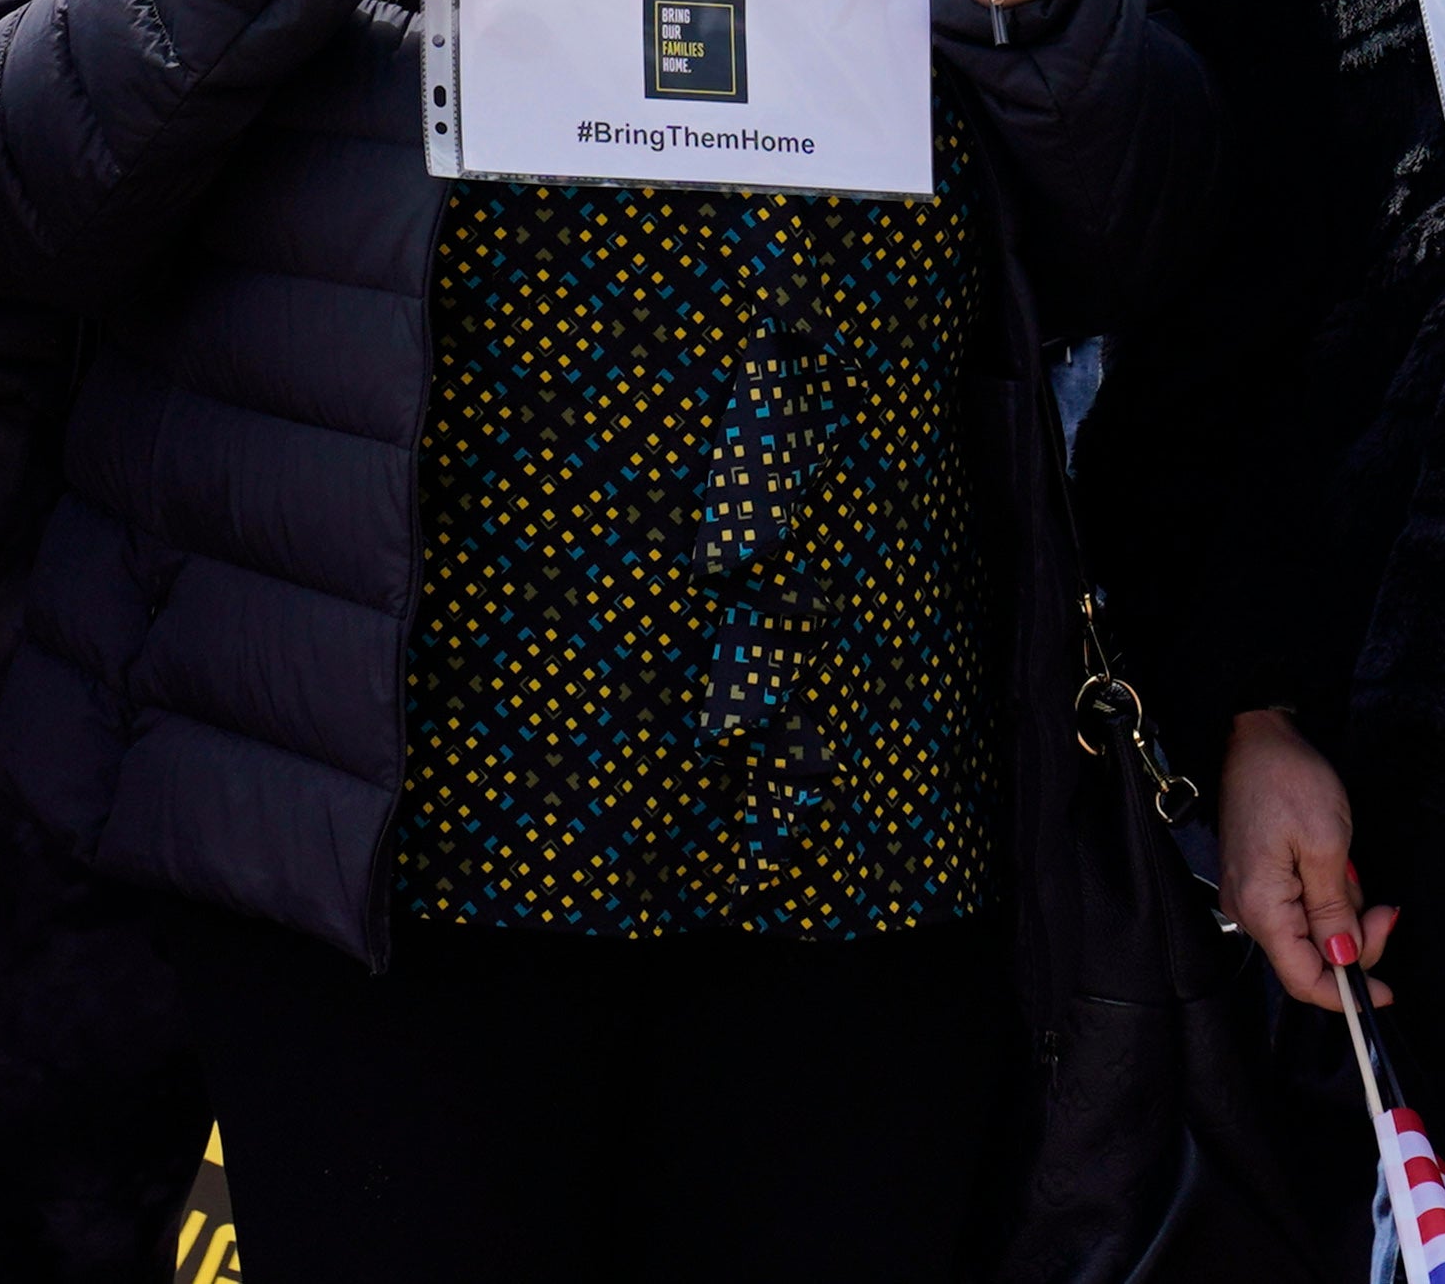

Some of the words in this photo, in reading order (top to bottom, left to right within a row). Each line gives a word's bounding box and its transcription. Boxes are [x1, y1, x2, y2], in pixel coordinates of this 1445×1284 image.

[662, 8, 690, 24] BRING
[662, 24, 681, 40] OUR
[662, 41, 704, 58] FAMILIES
[663, 57, 692, 73] HOME.
[577, 121, 815, 154] #BringThemHome
